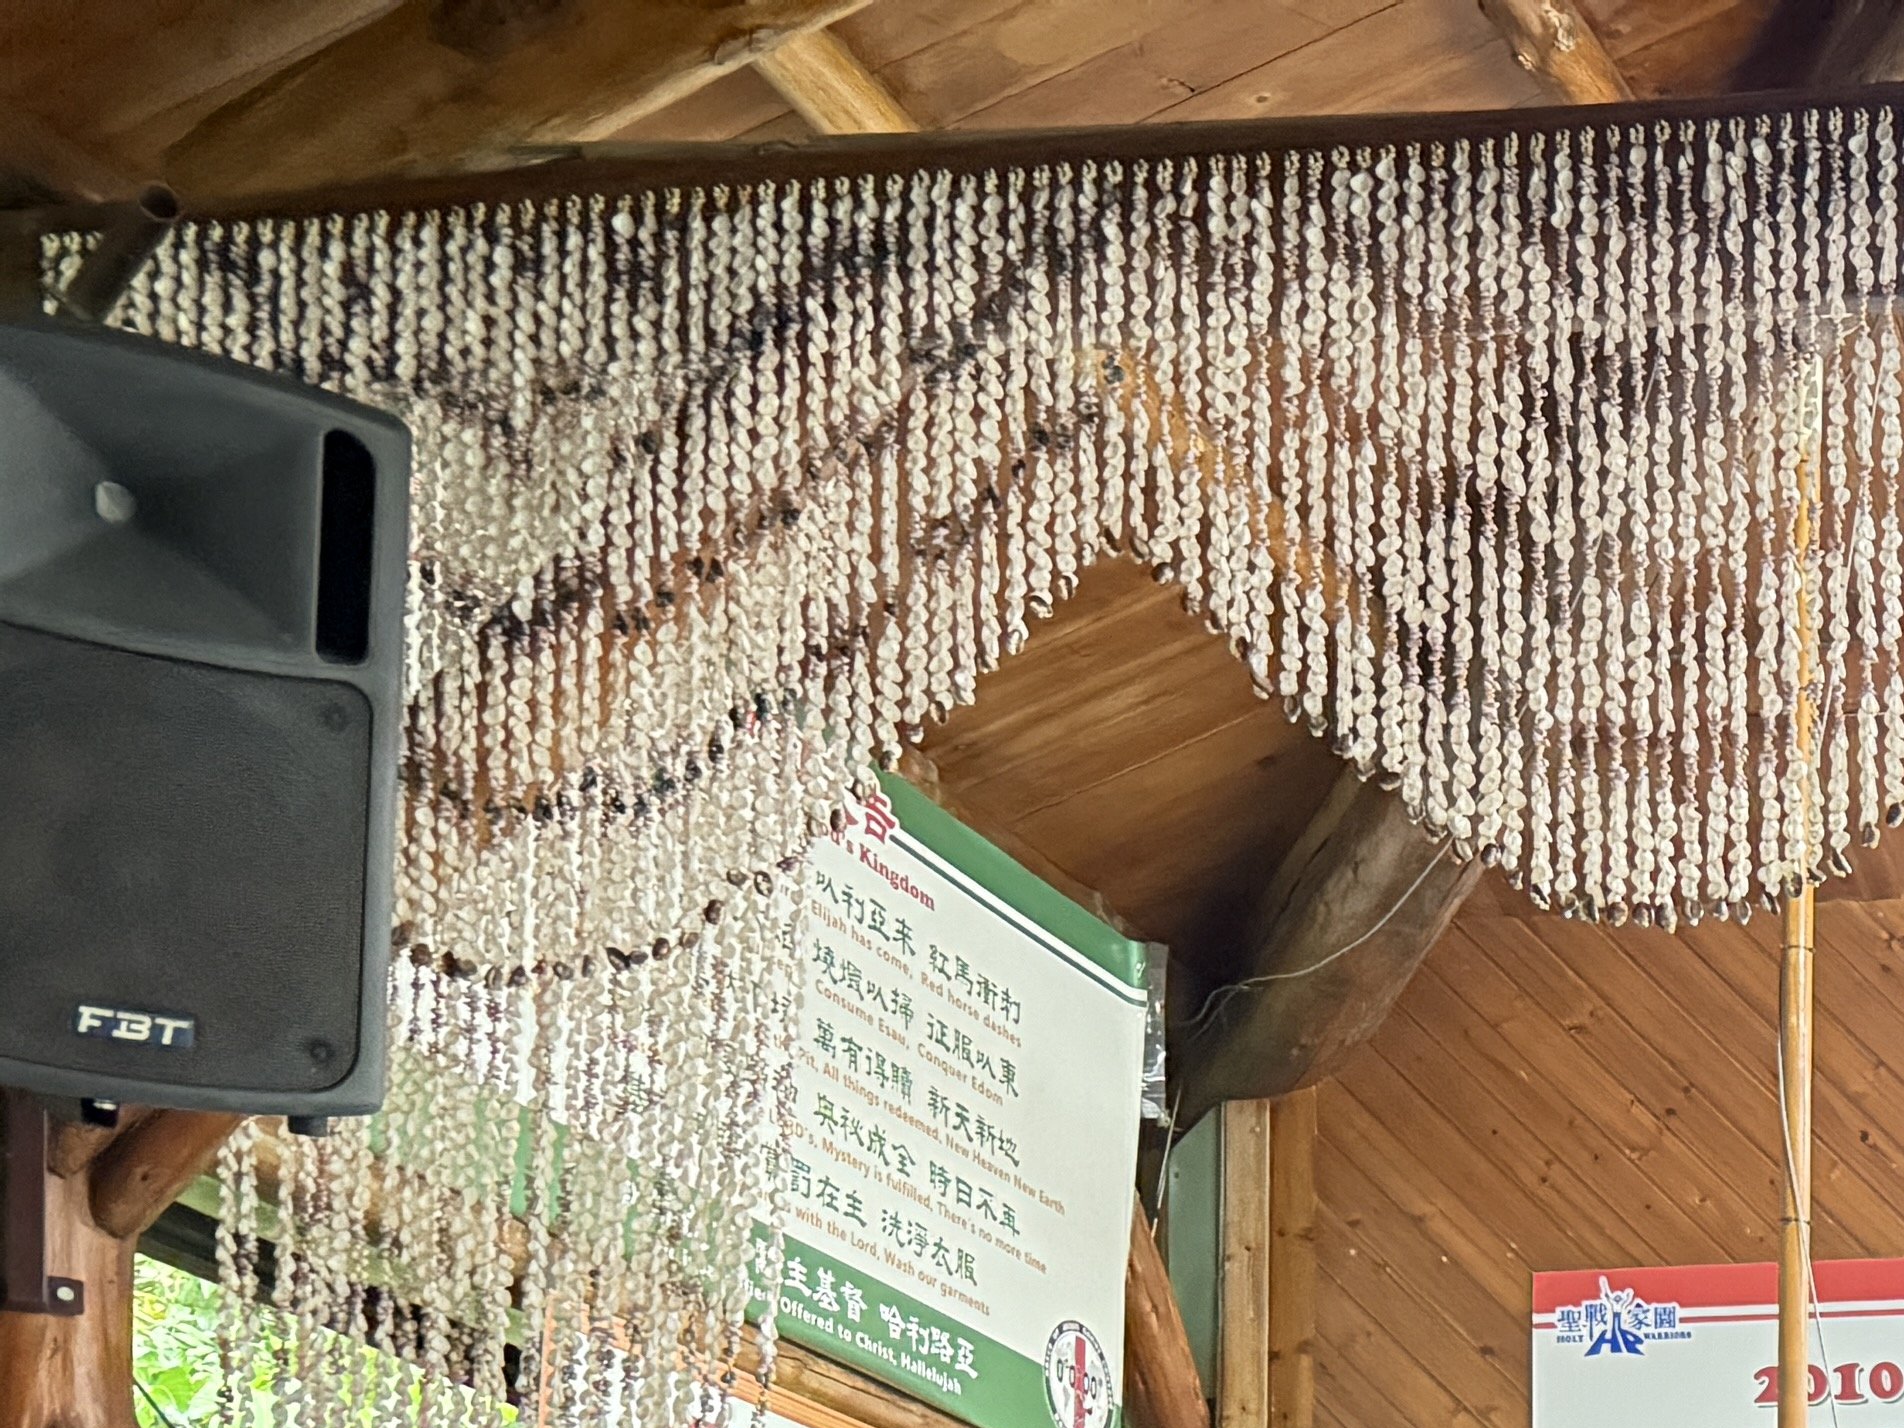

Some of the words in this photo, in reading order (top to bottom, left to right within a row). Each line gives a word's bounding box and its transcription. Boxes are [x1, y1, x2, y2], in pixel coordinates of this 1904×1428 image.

[859, 843, 935, 912] Kingdom
[77, 1007, 194, 1047] FBT
[814, 978, 875, 1028] Consume
[917, 1043, 968, 1084] Conquer
[971, 1076, 1004, 1107] Edom
[947, 986, 979, 1021] horse
[982, 1008, 1022, 1049] dashes
[821, 1136, 870, 1180] Mystery
[995, 1235, 1022, 1261] more
[1024, 1247, 1047, 1275] time
[972, 1147, 1010, 1183] Heaven
[1039, 1188, 1065, 1216] Earth
[795, 1205, 824, 1229] with
[883, 1248, 915, 1278] Wash
[940, 1276, 990, 1317] garments
[780, 1296, 835, 1335] Offered
[900, 1352, 963, 1396] Hallelujah
[879, 1302, 980, 1380] 哈利路亞
